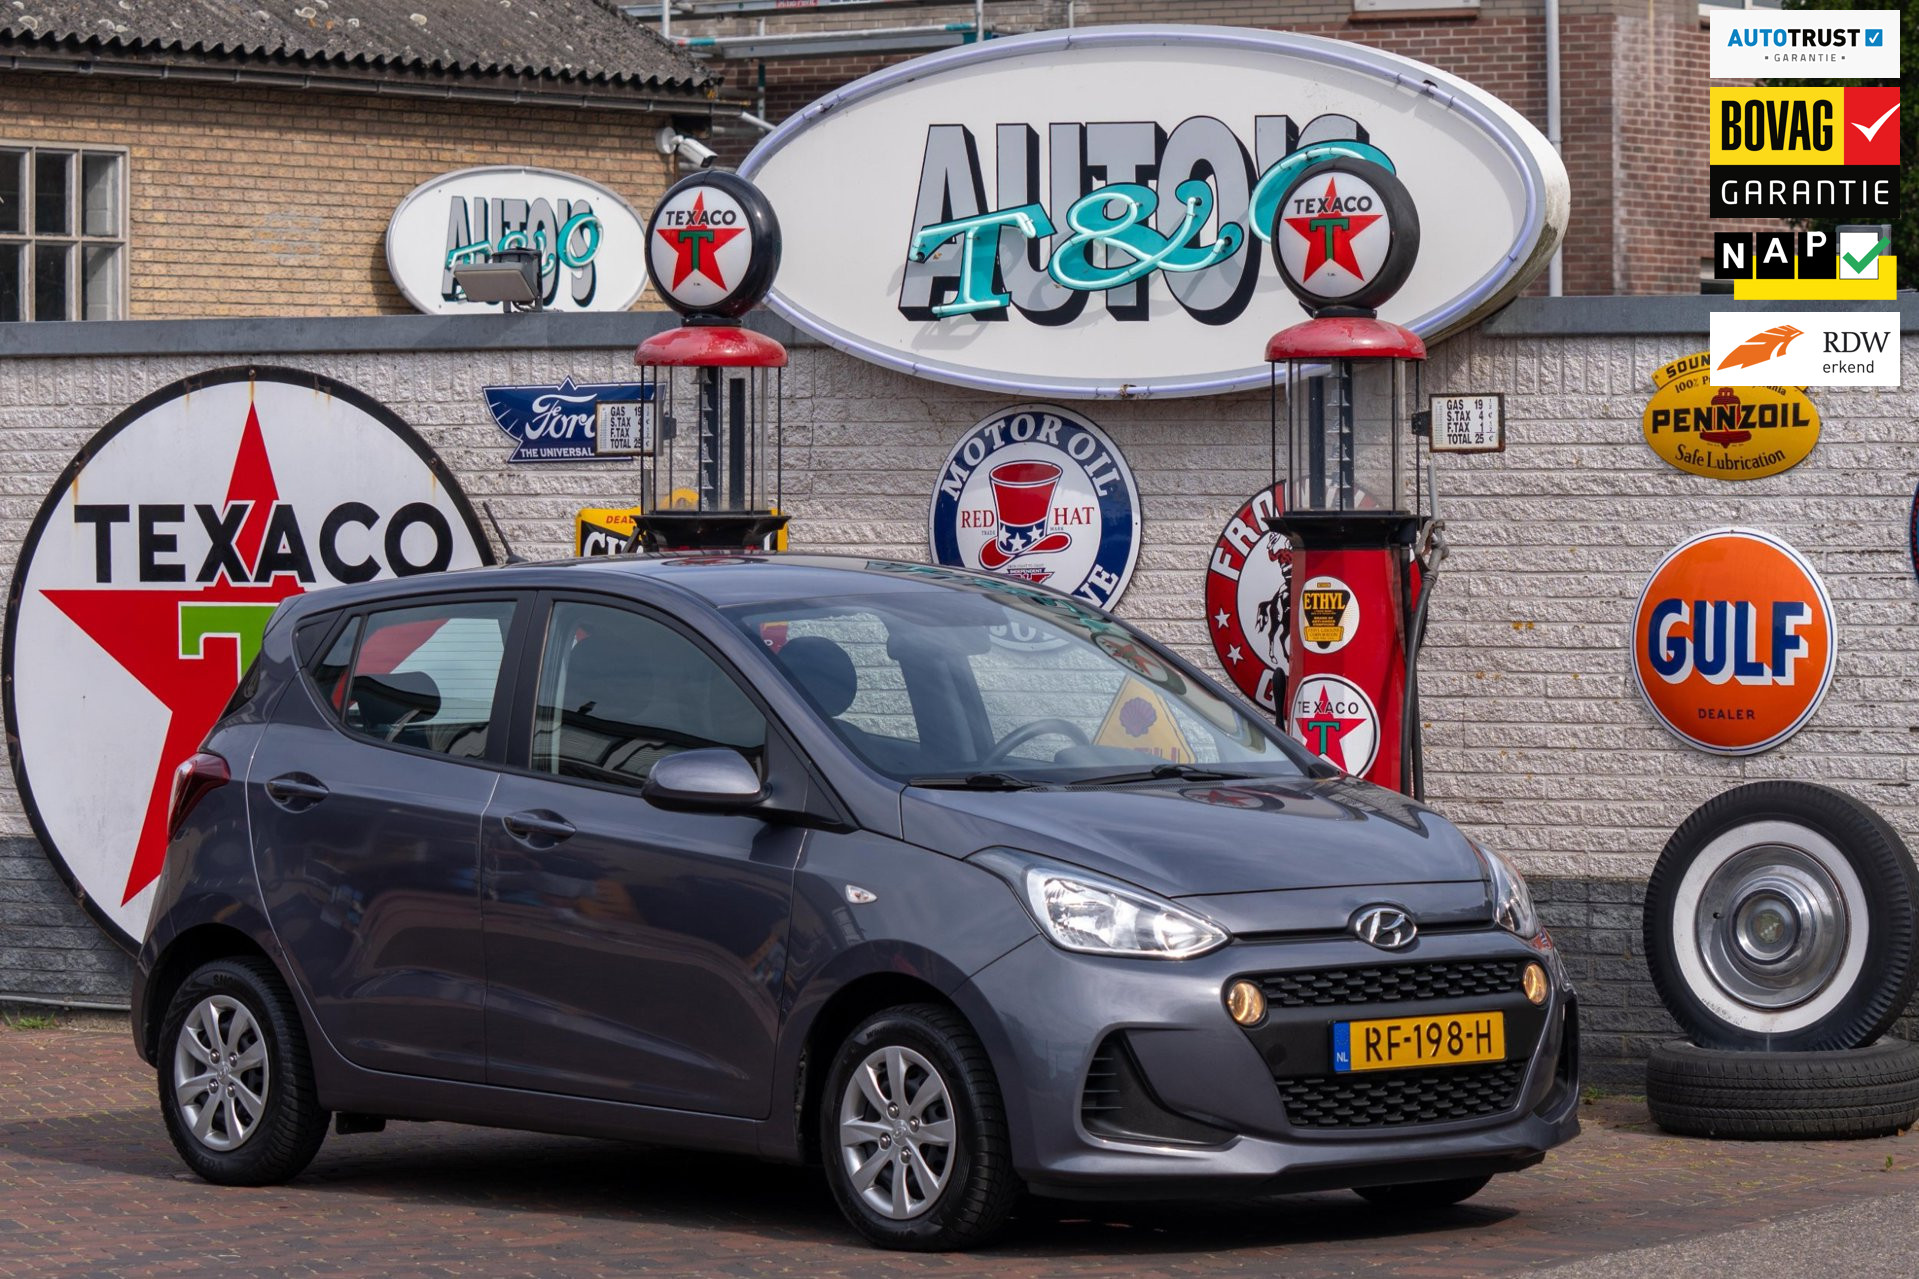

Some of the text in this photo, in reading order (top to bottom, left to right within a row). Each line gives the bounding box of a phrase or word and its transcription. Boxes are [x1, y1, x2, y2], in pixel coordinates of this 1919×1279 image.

[1294, 195, 1373, 214] TEXACO
[666, 209, 737, 226] TEXACO
[1666, 354, 1710, 379] SOUN
[610, 406, 626, 417] GAS
[1446, 399, 1464, 411] GAS
[1474, 399, 1484, 410] 19
[610, 417, 631, 427] S.TAX
[1446, 410, 1472, 422] S.TAX
[1478, 410, 1484, 421] 4
[1651, 402, 1811, 434] PENNZOIL
[610, 428, 630, 438] F.TAX
[1446, 422, 1470, 433] F.TAX
[1479, 422, 1484, 433] 1
[610, 438, 632, 449] TOTAL
[1446, 433, 1472, 445] TOTAL
[1474, 433, 1485, 444] 25
[520, 447, 595, 458] THE UNIVERSAL
[941, 414, 1120, 501] MOTOR OIL
[1675, 443, 1786, 470] Safe Lubrication
[961, 506, 1095, 529] RED HAT
[74, 501, 454, 585] TEXACO
[1303, 592, 1346, 610] ETHYL
[1648, 598, 1813, 686] GULF
[1297, 701, 1359, 715] TEXACO
[1697, 708, 1756, 721] DEALER
[1336, 1018, 1493, 1063] NL RF-198-H
